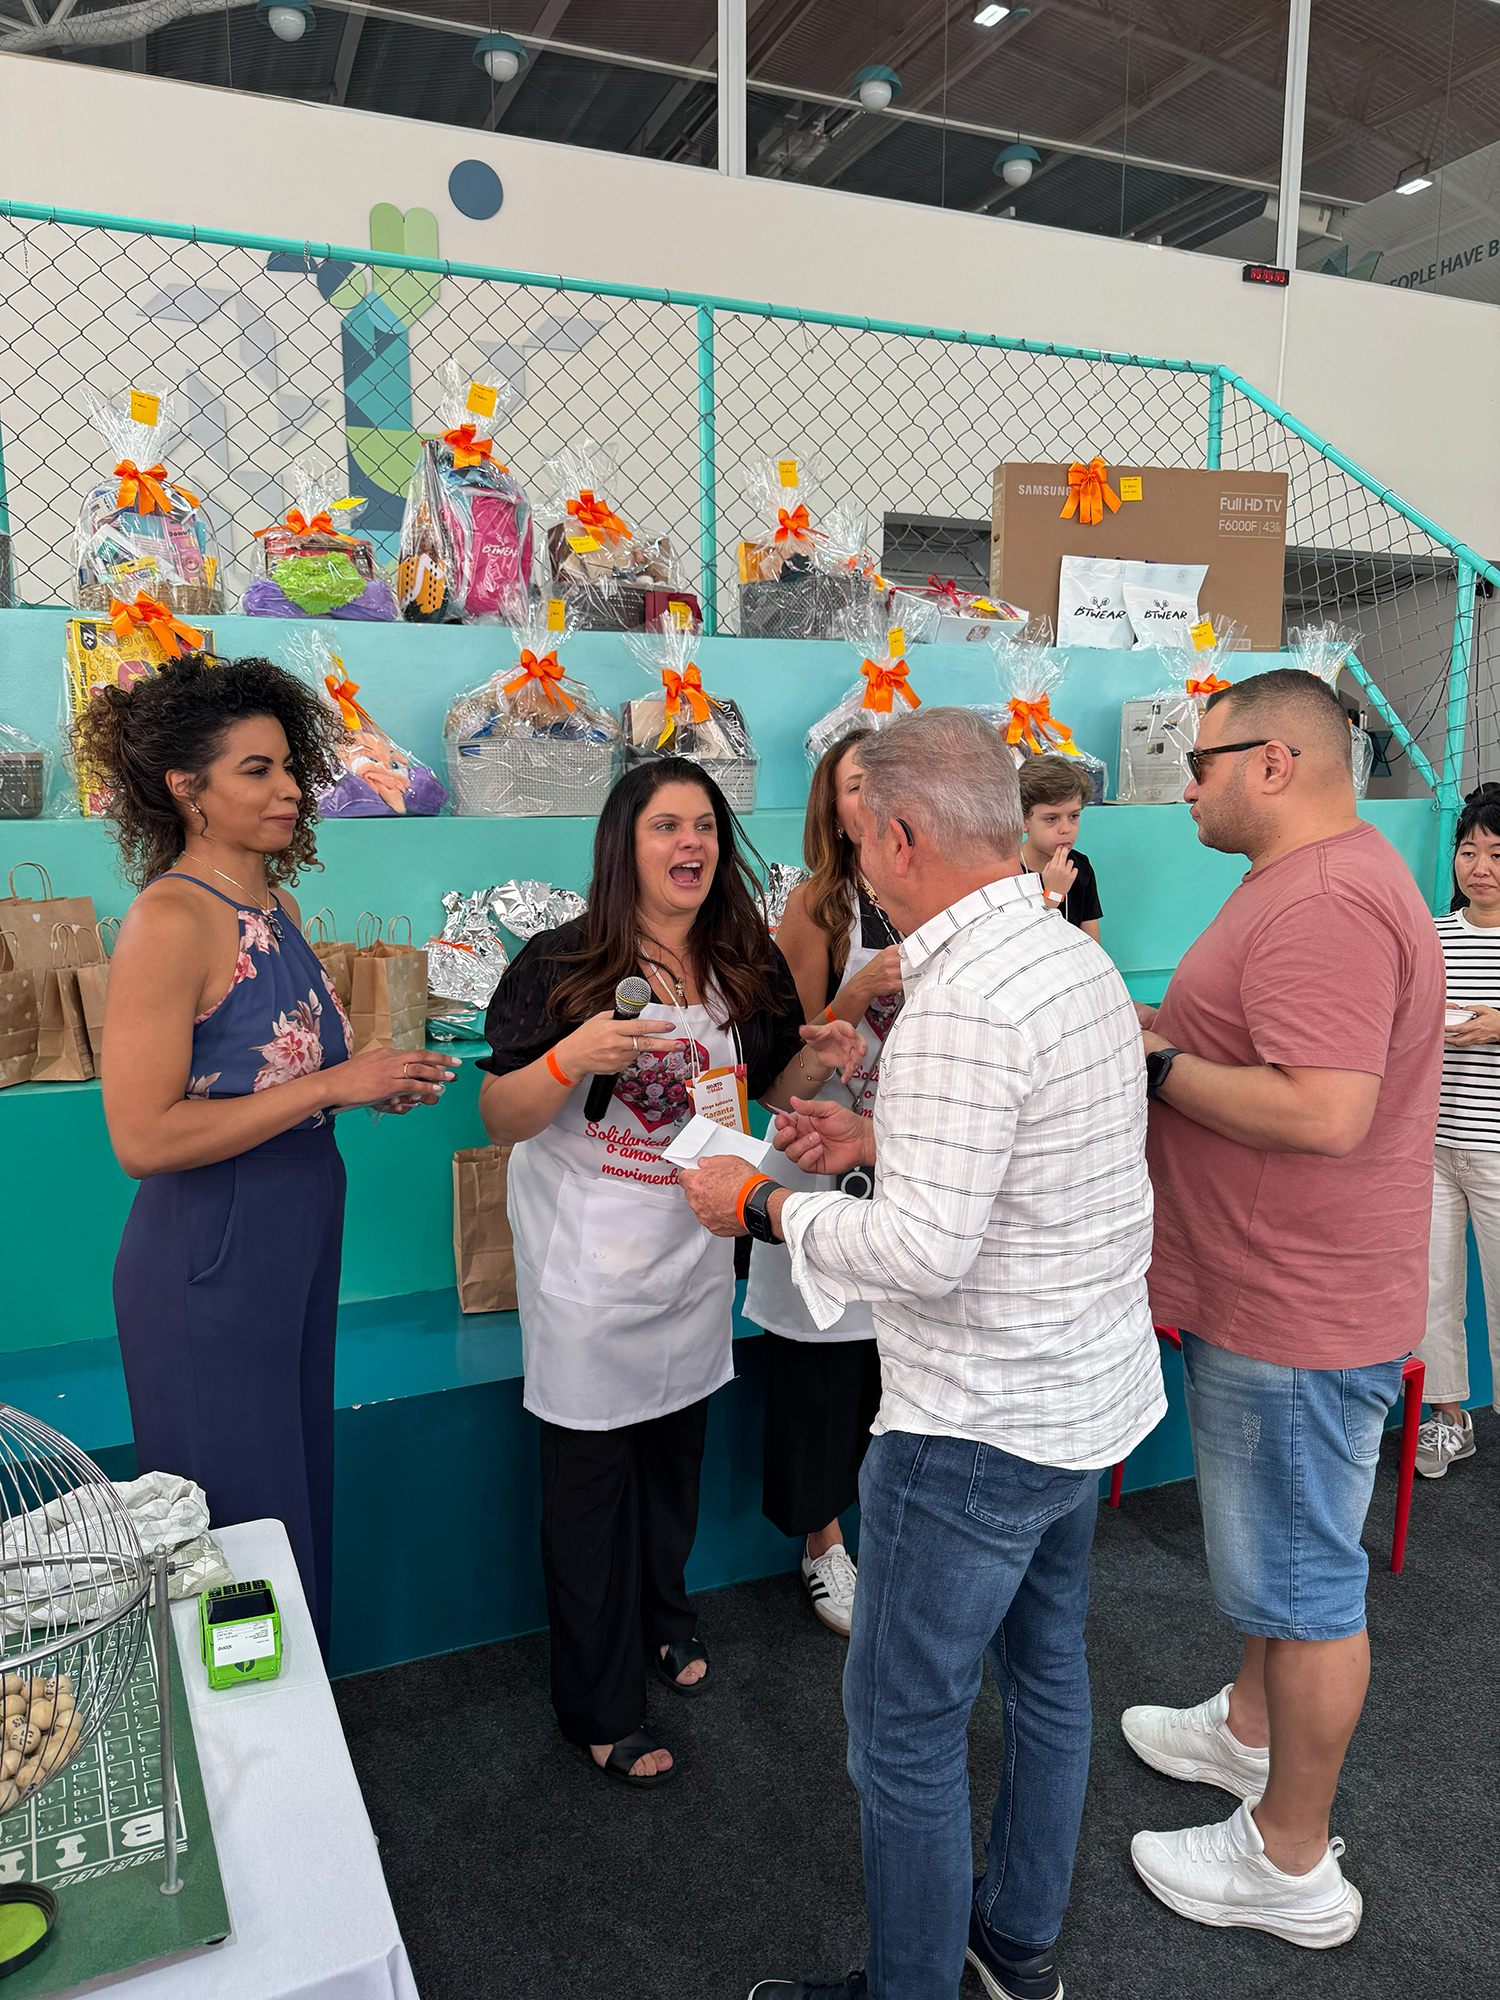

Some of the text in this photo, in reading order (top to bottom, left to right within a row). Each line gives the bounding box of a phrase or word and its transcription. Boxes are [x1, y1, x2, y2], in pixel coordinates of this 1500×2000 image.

[1441, 244, 1484, 276] HAVE
[1220, 497, 1283, 512] Full HD TV
[1219, 519, 1257, 532] F6000F
[1073, 605, 1126, 620] BTWEAR
[1144, 610, 1188, 620] BTWEAR
[703, 1107, 734, 1119] Garanta
[585, 1121, 671, 1147] Solidaried
[606, 1144, 663, 1163] o amor
[71, 1761, 87, 1770] 20
[74, 1788, 88, 1796] 18
[38, 1798, 53, 1806] 19
[74, 1815, 89, 1824] 16
[38, 1825, 54, 1834] 17
[120, 1811, 165, 1847] B
[55, 1834, 87, 1868] I
